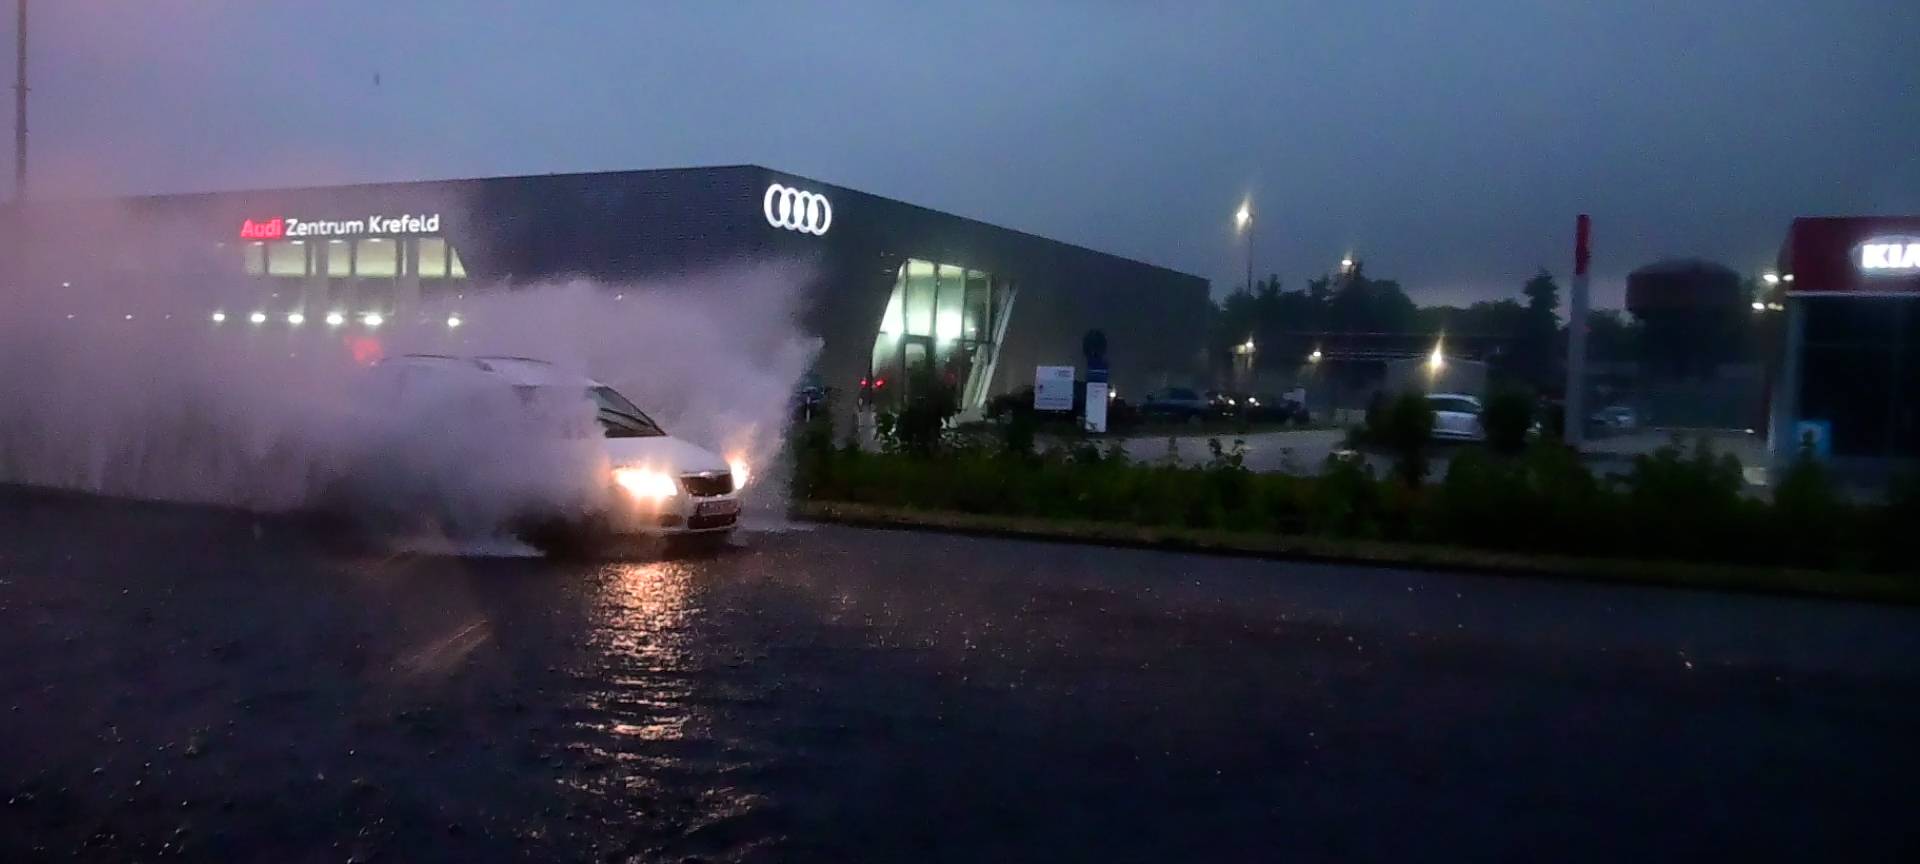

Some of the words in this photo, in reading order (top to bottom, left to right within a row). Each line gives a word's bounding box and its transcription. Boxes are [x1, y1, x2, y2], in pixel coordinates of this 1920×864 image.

[241, 218, 282, 238] Audi
[285, 218, 364, 236] Zentrum
[368, 214, 440, 232] Krefeld
